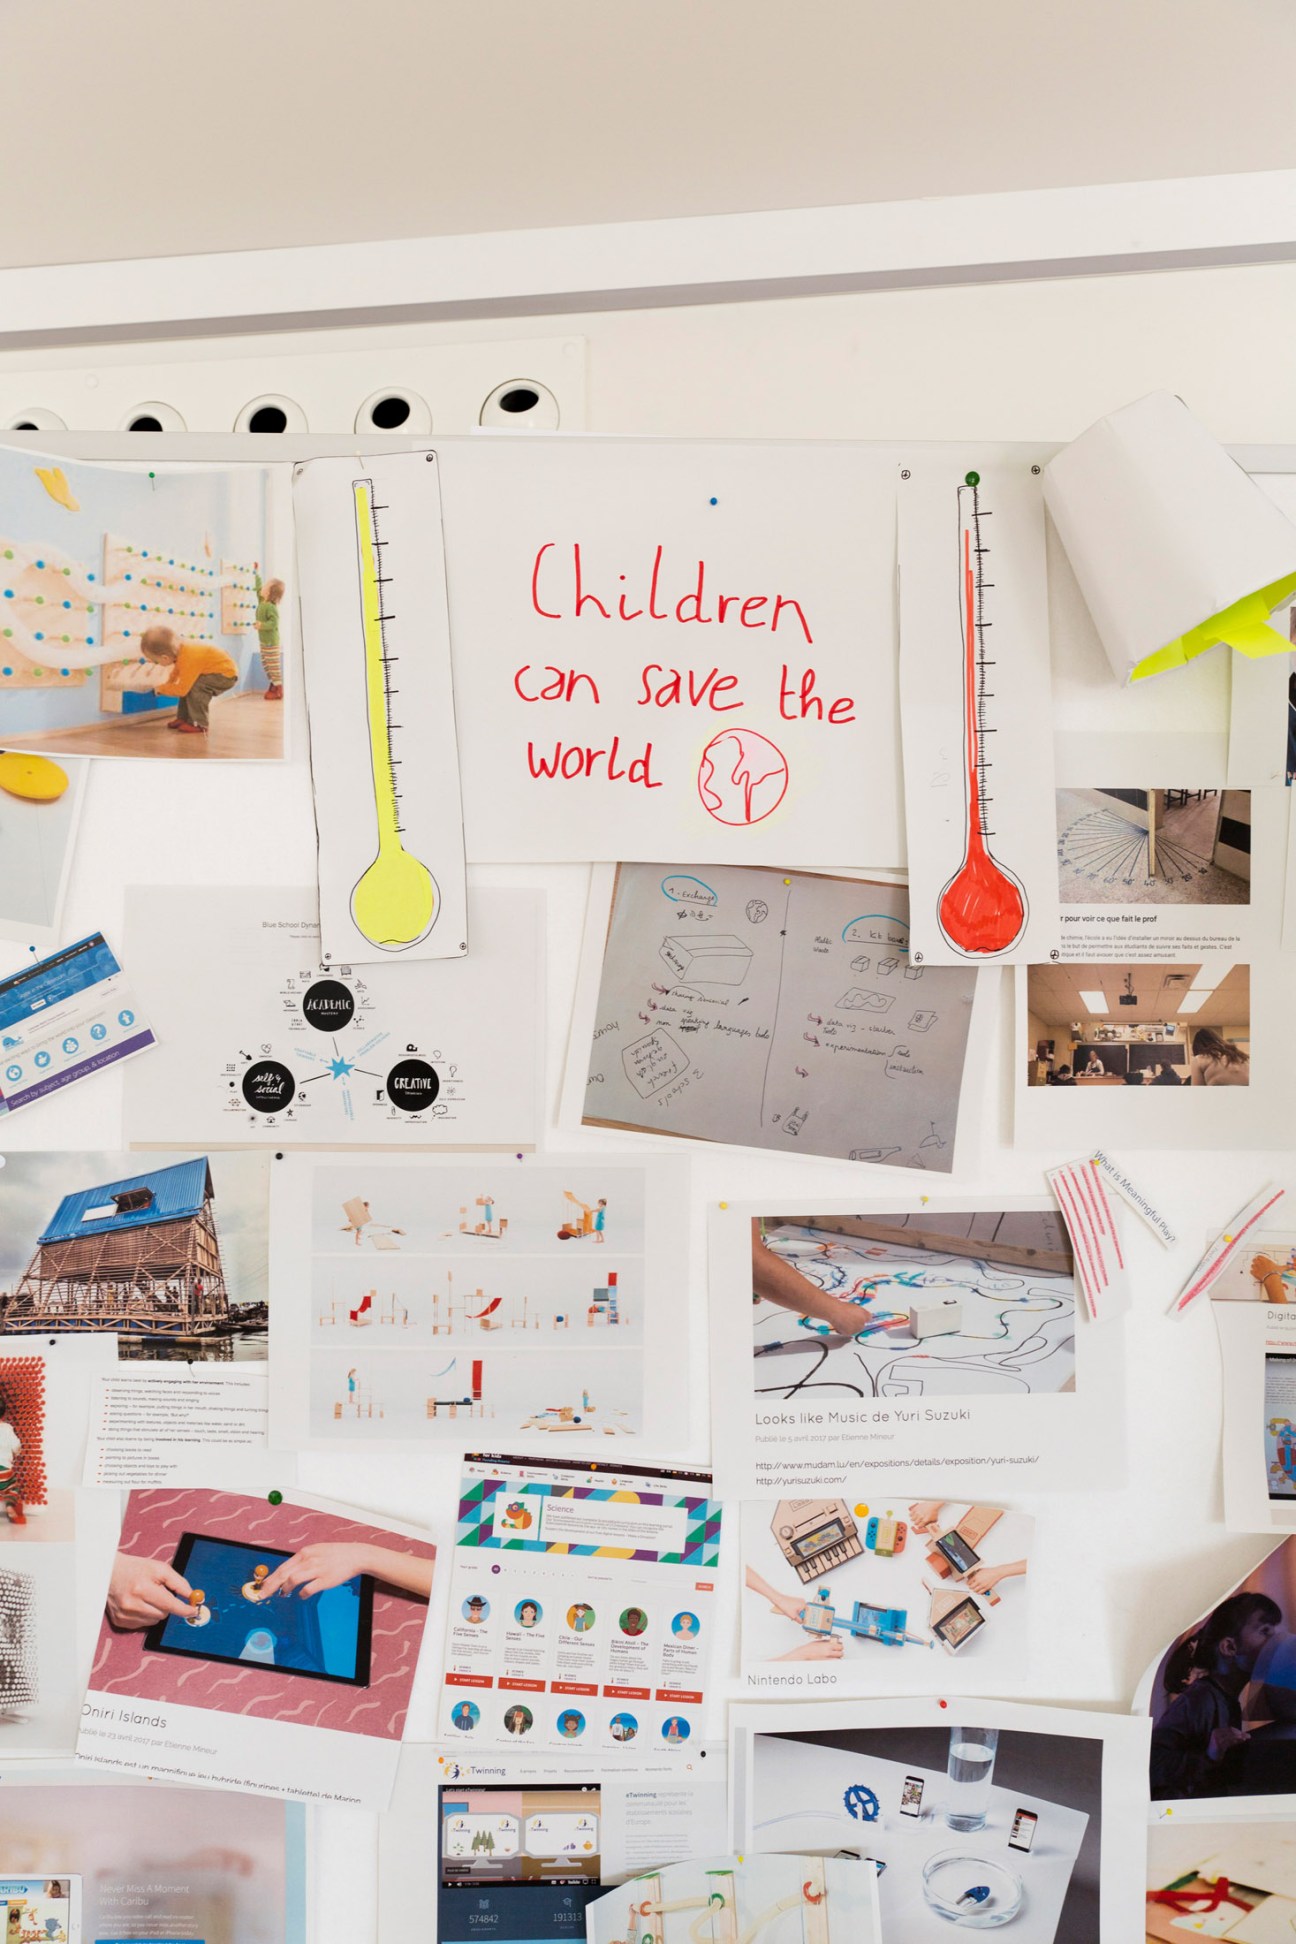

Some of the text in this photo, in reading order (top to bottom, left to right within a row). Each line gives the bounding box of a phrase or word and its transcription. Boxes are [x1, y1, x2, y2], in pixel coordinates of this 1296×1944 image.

[532, 542, 814, 644] Children
[514, 664, 857, 724] can save the
[527, 735, 663, 788] world
[1106, 916, 1120, 924] que
[1122, 914, 1133, 922] fait
[1142, 915, 1157, 924] prof
[306, 998, 352, 1011] ACADEMIC
[251, 1072, 275, 1086] self
[394, 1077, 432, 1090] CREATIVE
[254, 1082, 285, 1095] social
[1094, 1150, 1177, 1242] What is Meaningful Play?
[755, 1409, 971, 1425] Looks like Music de Yuri Suzuki
[755, 1435, 778, 1444] Publié
[779, 1435, 787, 1443] le
[788, 1436, 793, 1444] 5
[794, 1434, 809, 1443] avril
[810, 1435, 827, 1443] 2017
[828, 1435, 840, 1443] par
[870, 1433, 895, 1441] Mineur
[756, 1476, 848, 1487] http://yurisuzuki.com/
[546, 1504, 575, 1514] Science
[453, 1626, 476, 1634] California
[747, 1674, 838, 1686] Nintendo Labo
[80, 1703, 168, 1729] Oniri Islands
[107, 1732, 116, 1740] 23
[134, 1736, 151, 1745] 2017
[151, 1739, 163, 1747] par
[466, 1766, 506, 1777] eTwinning
[100, 1884, 190, 1894] Never Miss A Moment
[121, 1896, 149, 1906] Caribu
[468, 1912, 583, 1924] 574842 191313
